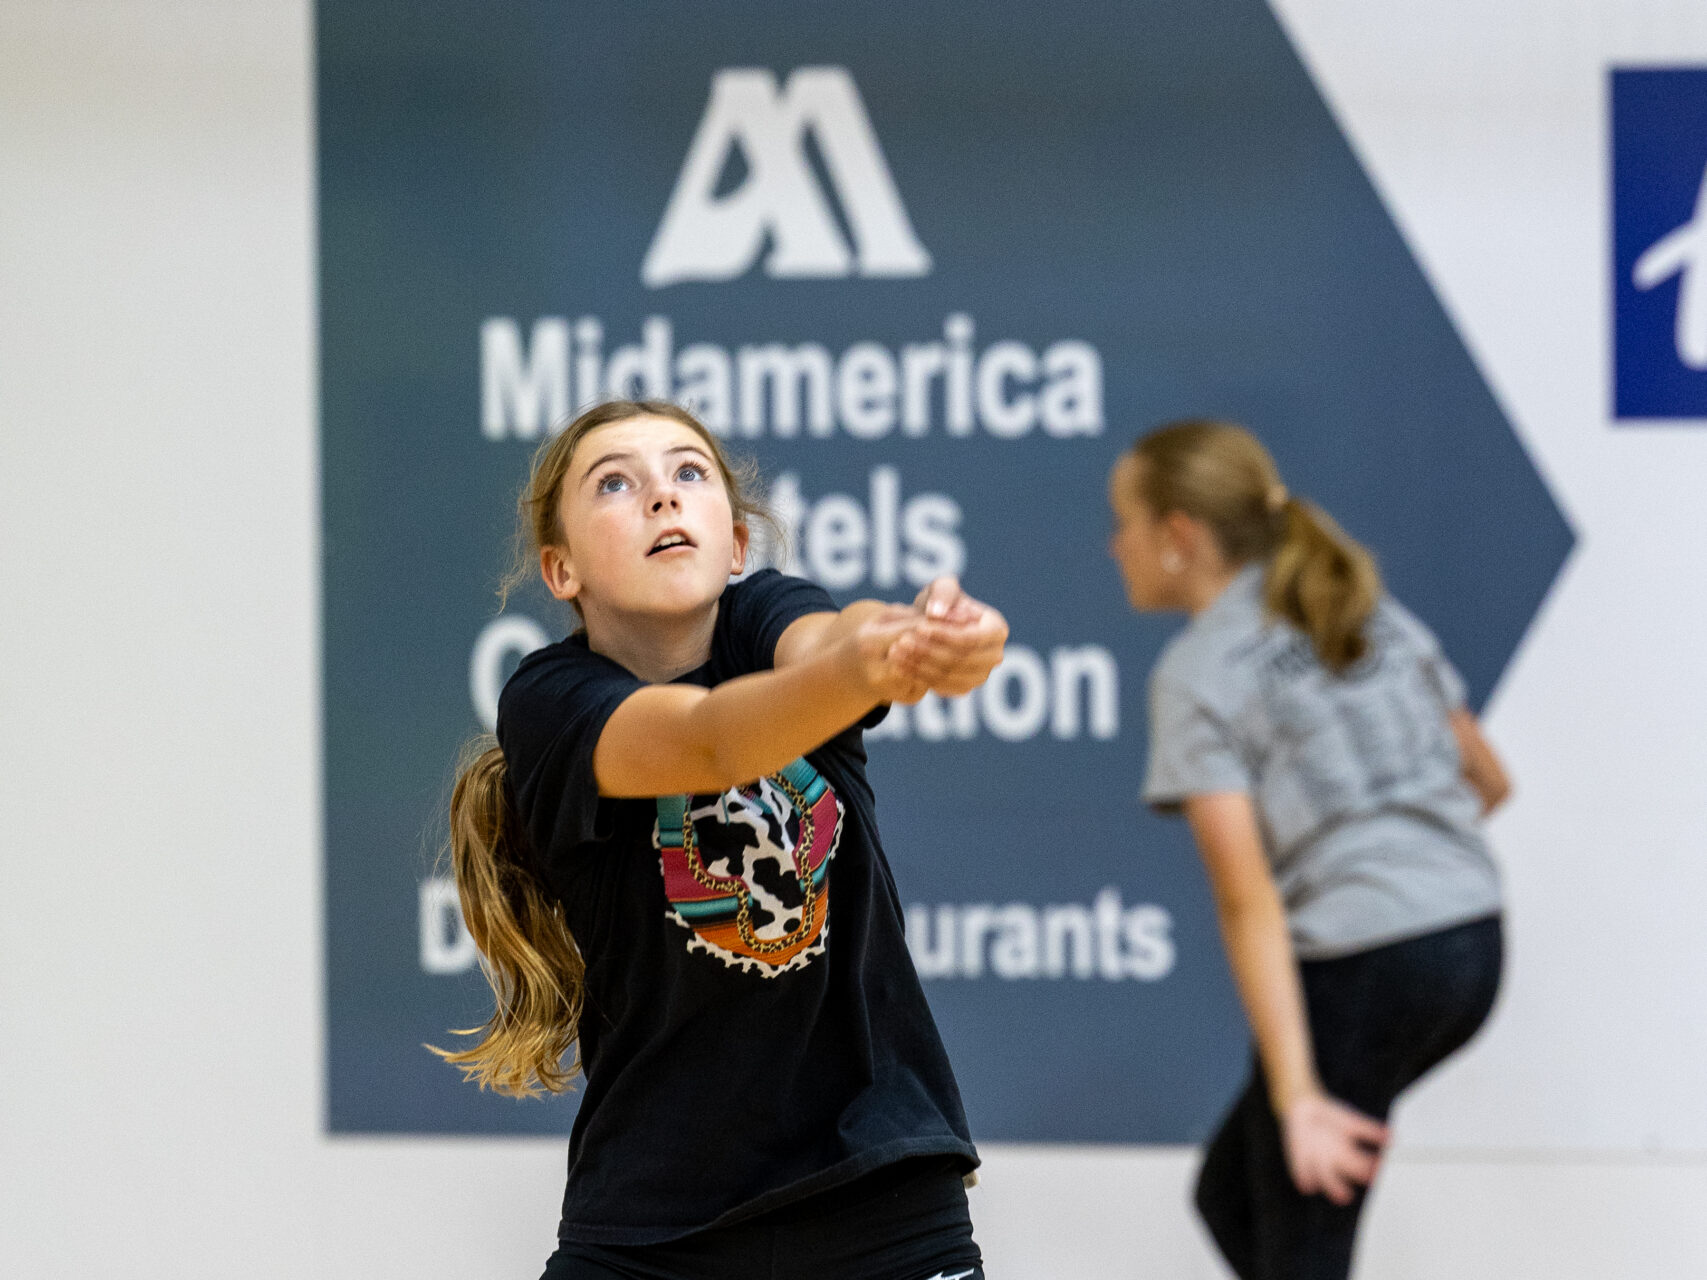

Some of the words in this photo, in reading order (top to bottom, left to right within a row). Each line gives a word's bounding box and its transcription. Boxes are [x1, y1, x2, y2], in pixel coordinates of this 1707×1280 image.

[481, 315, 1104, 439] Midamerica
[736, 466, 966, 589] tels
[906, 888, 1175, 979] urants
